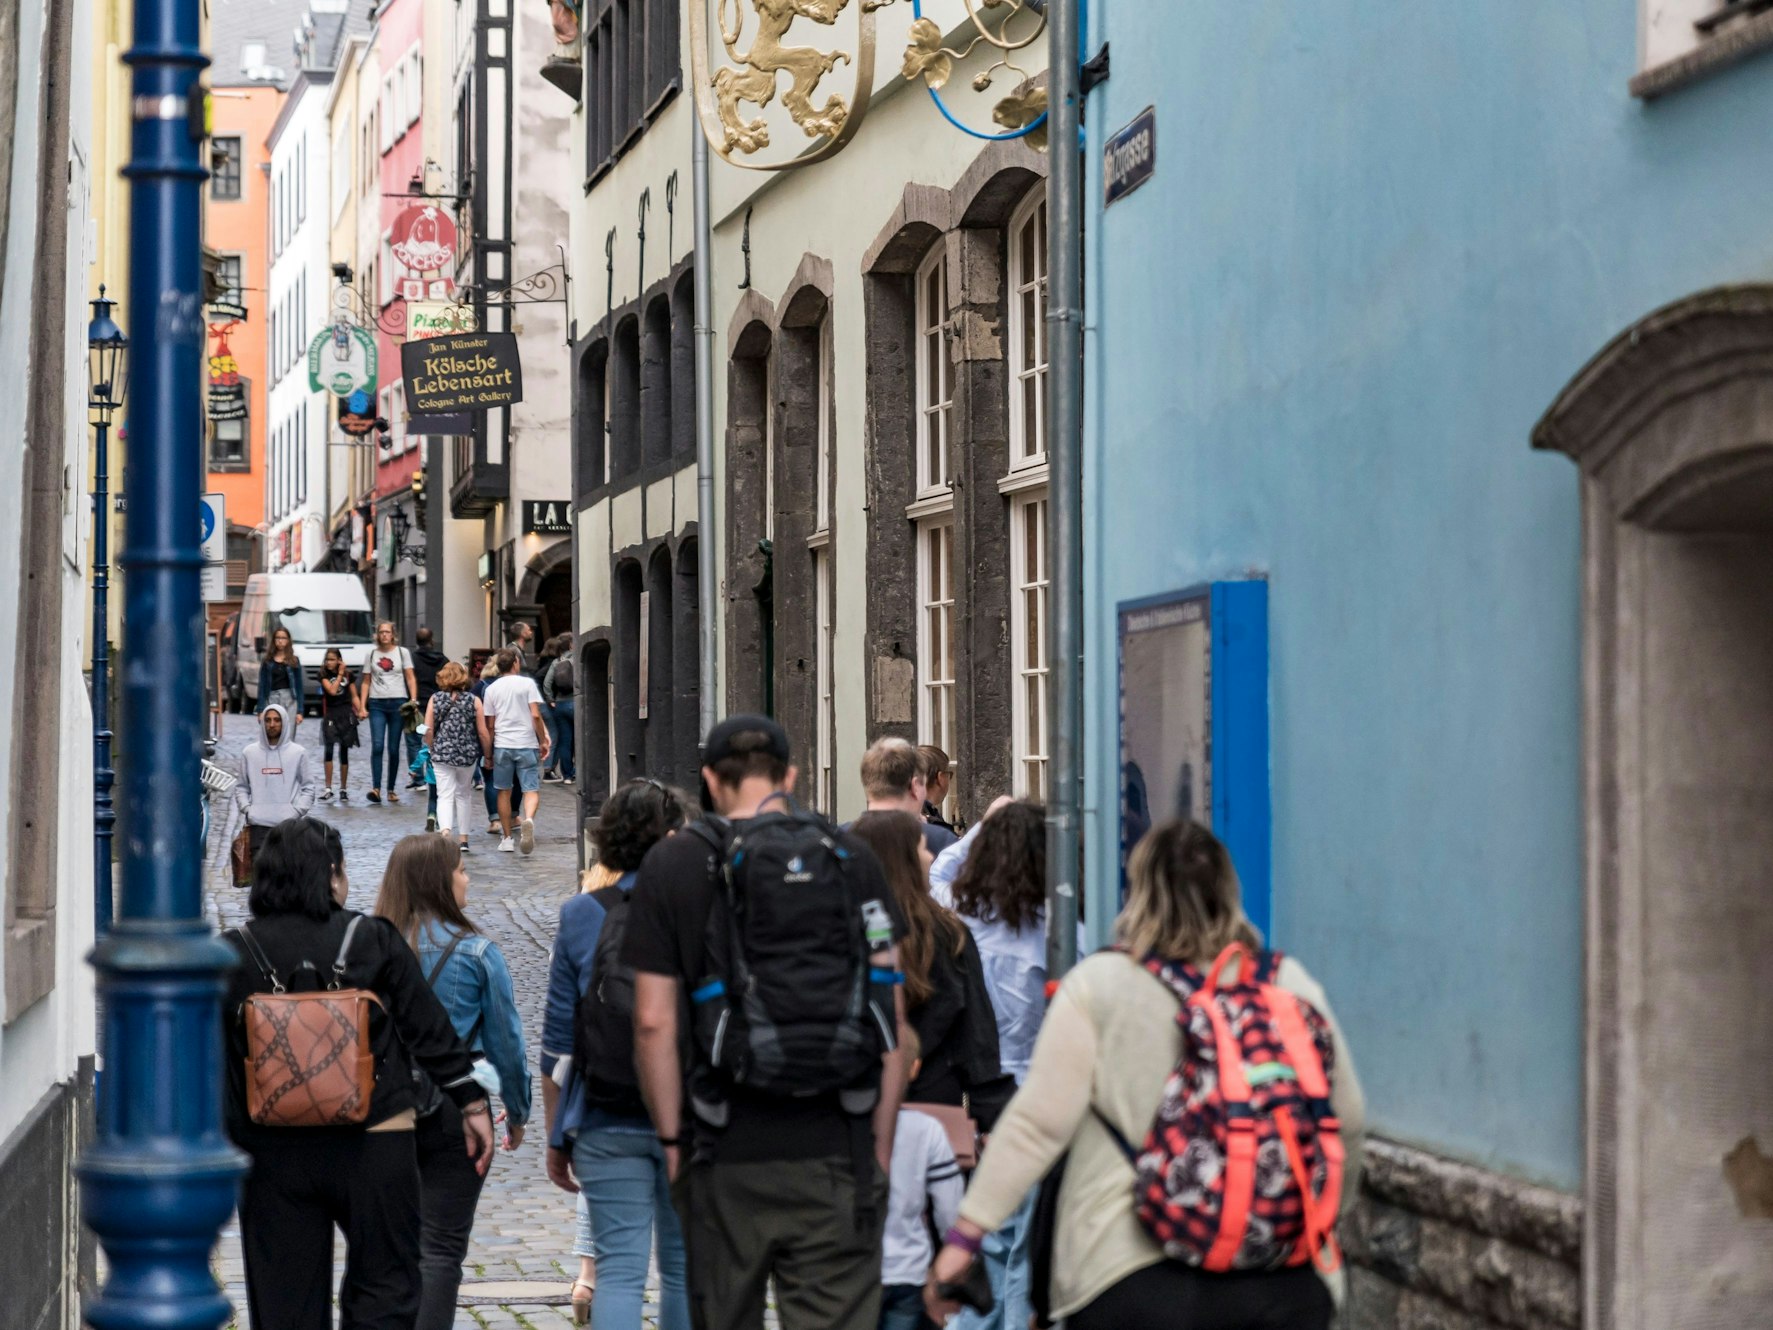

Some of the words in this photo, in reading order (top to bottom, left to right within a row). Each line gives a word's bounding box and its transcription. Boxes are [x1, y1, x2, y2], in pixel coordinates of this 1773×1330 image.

[428, 342, 447, 354] Jan
[451, 339, 488, 350] Künster
[423, 354, 497, 376] Kölsche
[412, 368, 512, 395] Lebensart
[417, 398, 454, 409] Cologne
[458, 395, 474, 404] Art
[478, 391, 512, 402] Gallery
[533, 502, 557, 525] LA
